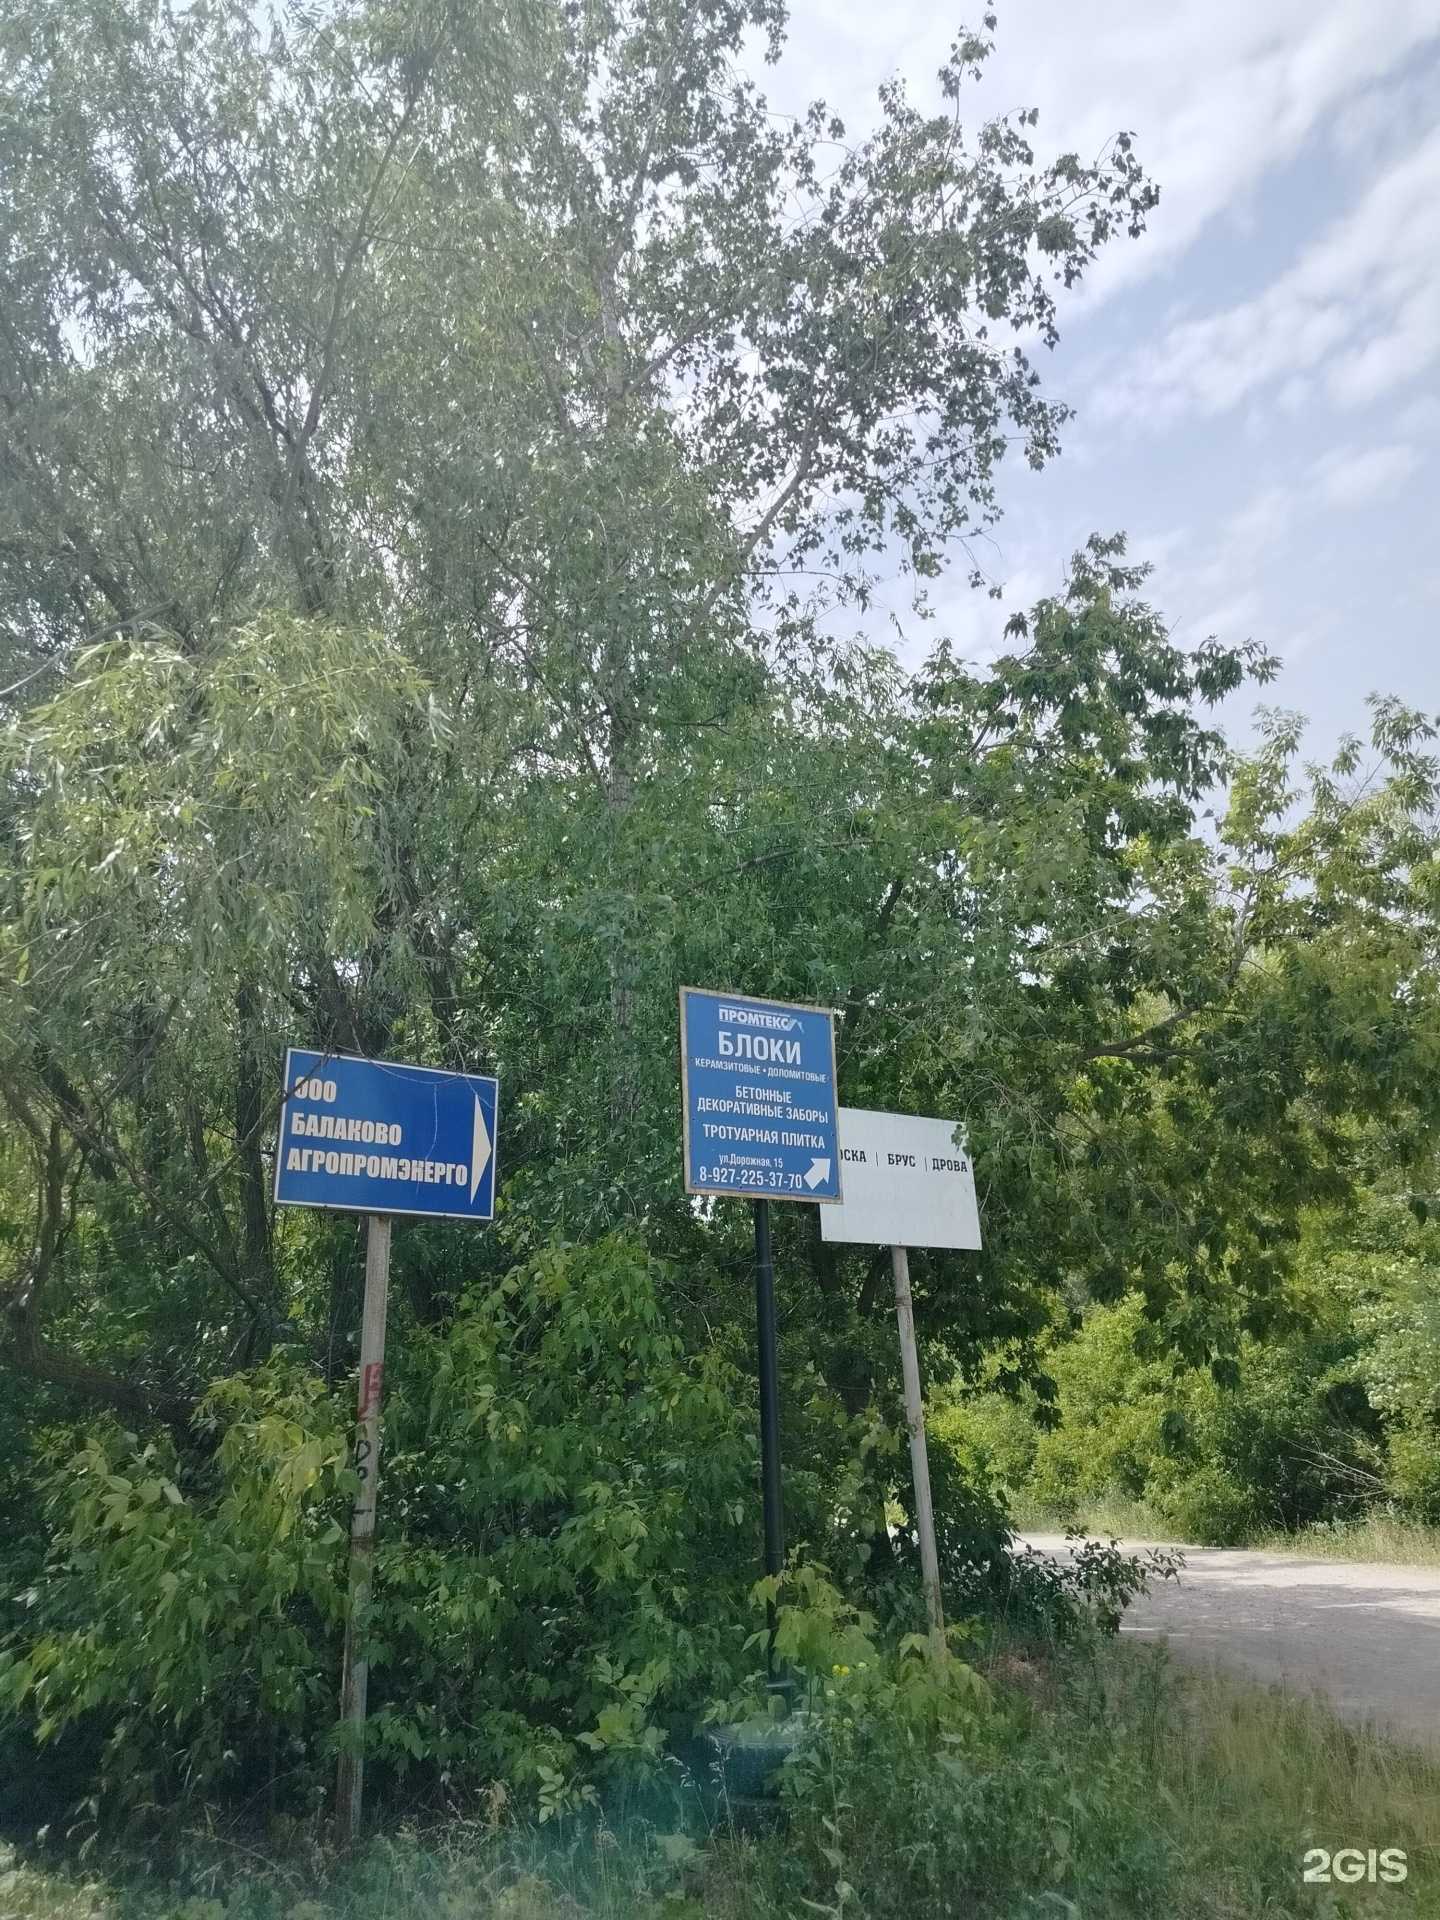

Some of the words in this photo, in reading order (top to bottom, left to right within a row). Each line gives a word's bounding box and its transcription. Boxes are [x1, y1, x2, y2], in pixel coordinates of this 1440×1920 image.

[719, 1008, 792, 1030] ПРОМТЕКС
[718, 1031, 802, 1065] БЛОКИ
[695, 1058, 760, 1074] КЕРАМЗИТОВЫЕ
[767, 1067, 827, 1083] ДОЛОМИТОВЫЕ
[294, 1076, 337, 1103] ООО
[735, 1085, 792, 1104] БЕТОННЫЕ
[697, 1097, 783, 1119] ДЕКОРАТИВНЫЕ
[786, 1107, 829, 1124] ЗАБОРЫ
[291, 1112, 402, 1146] БАЛАКОВО
[703, 1124, 778, 1144] ТРОТУАРНАЯ
[781, 1132, 826, 1149] ПЛИТКА
[287, 1148, 468, 1186] АГРОПРОМЭНЕРГО
[774, 1158, 783, 1168] 15
[887, 1153, 916, 1167] БРУС
[932, 1158, 968, 1172] ДРОВА
[699, 1166, 803, 1189] 8-927-225-37-70
